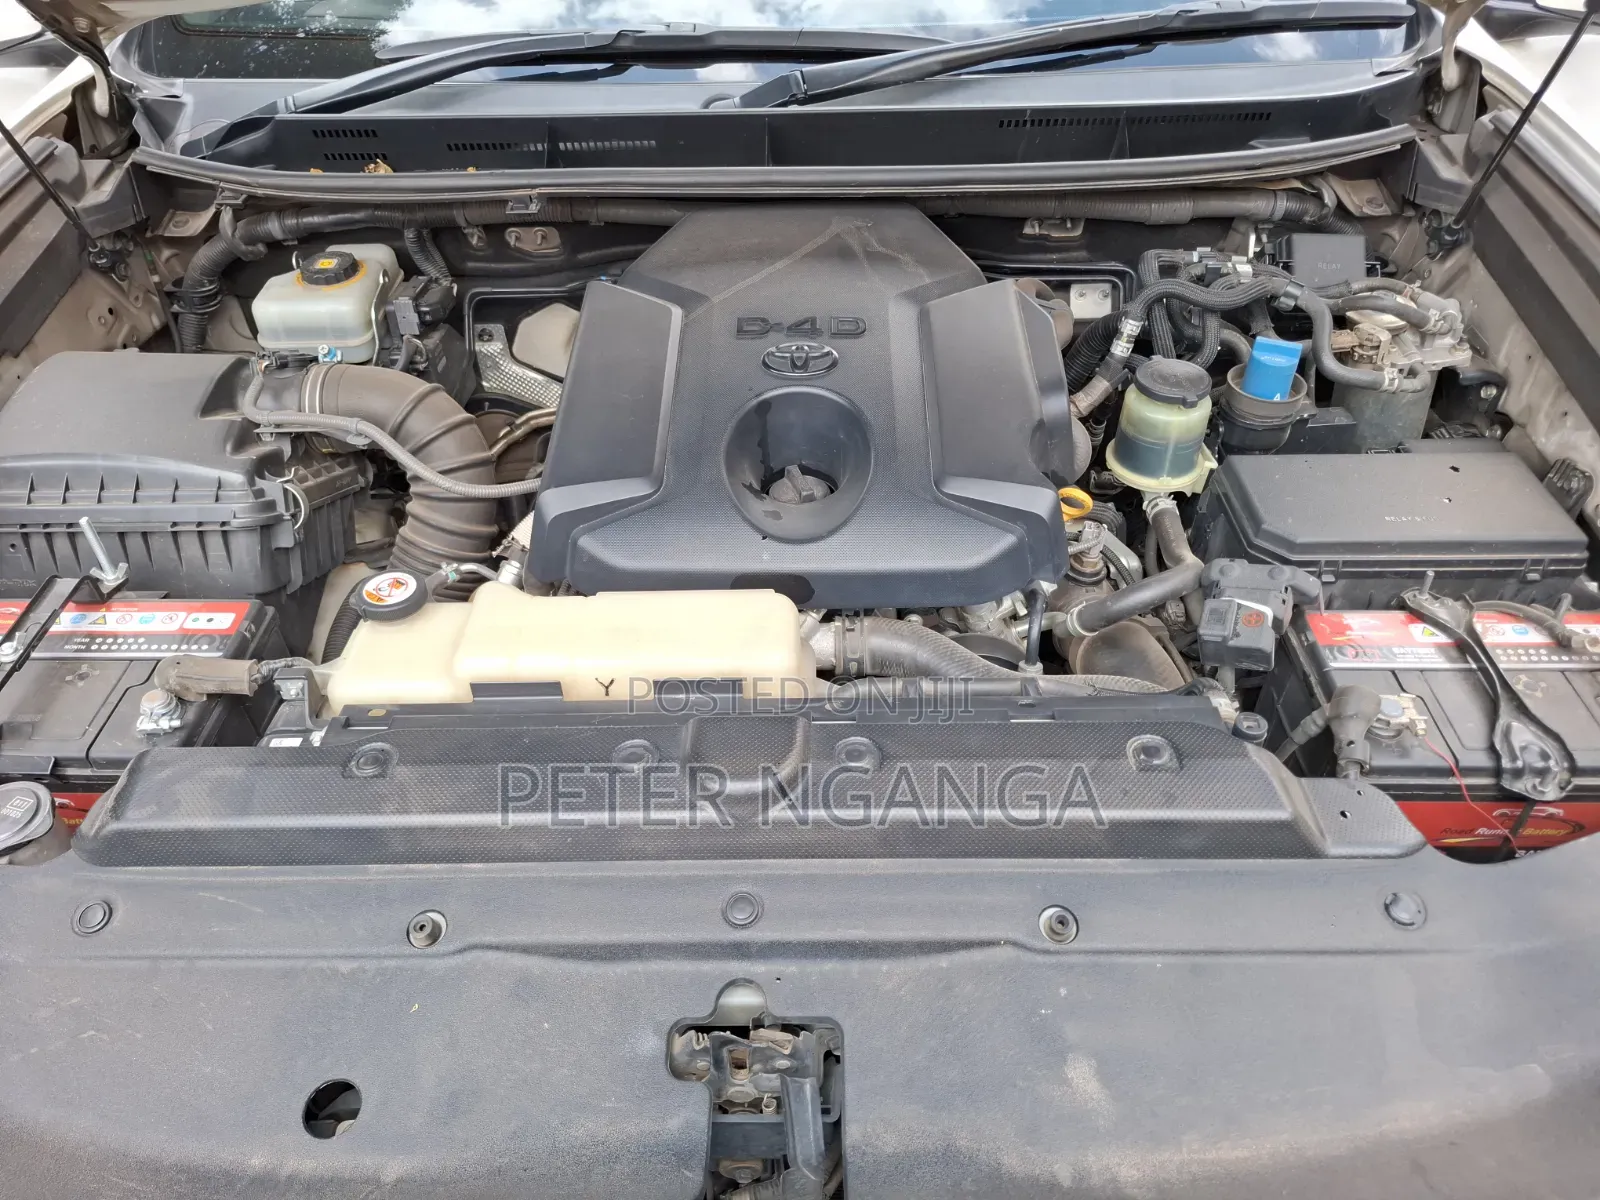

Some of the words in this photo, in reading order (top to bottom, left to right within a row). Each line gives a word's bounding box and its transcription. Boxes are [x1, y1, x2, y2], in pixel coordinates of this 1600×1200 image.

[1317, 262, 1341, 270] RELAY
[736, 316, 867, 338] D-4D
[1522, 828, 1570, 836] Battery
